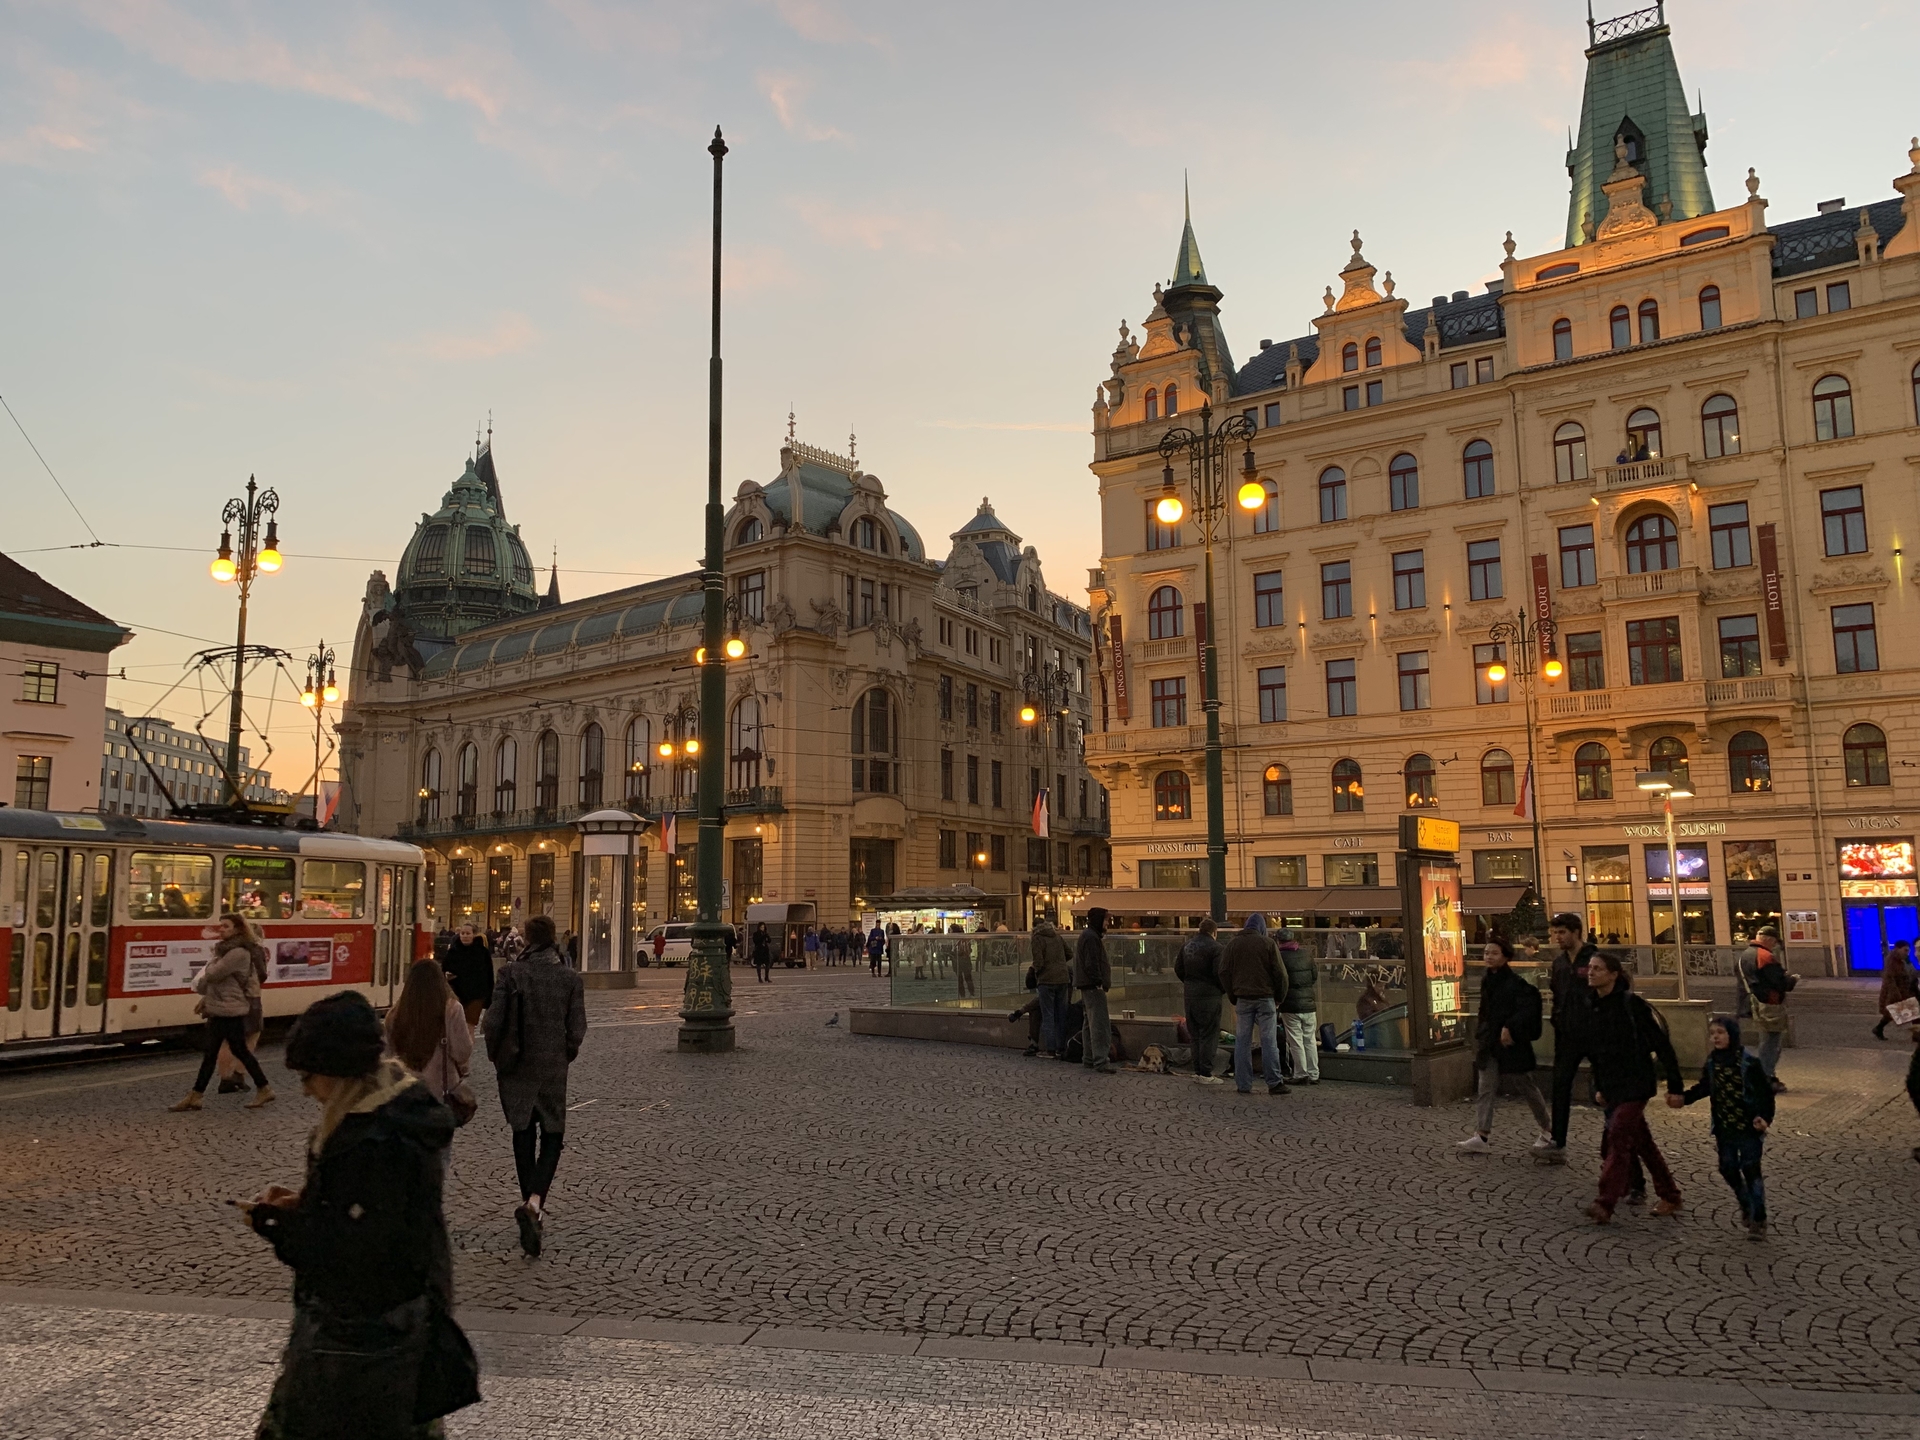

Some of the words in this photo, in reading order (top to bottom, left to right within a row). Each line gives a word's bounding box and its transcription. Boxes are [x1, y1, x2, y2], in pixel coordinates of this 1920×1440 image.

[1766, 570, 1780, 611] HOTEL
[1538, 585, 1549, 619] COURT
[1114, 640, 1123, 668] COURT
[1116, 670, 1125, 698] KINGS
[1623, 825, 1662, 837] WOK
[1679, 822, 1726, 836] SUSHI
[1847, 815, 1902, 830] VEGAS
[1488, 831, 1514, 843] BAR
[1147, 842, 1200, 854] BRASSERIE
